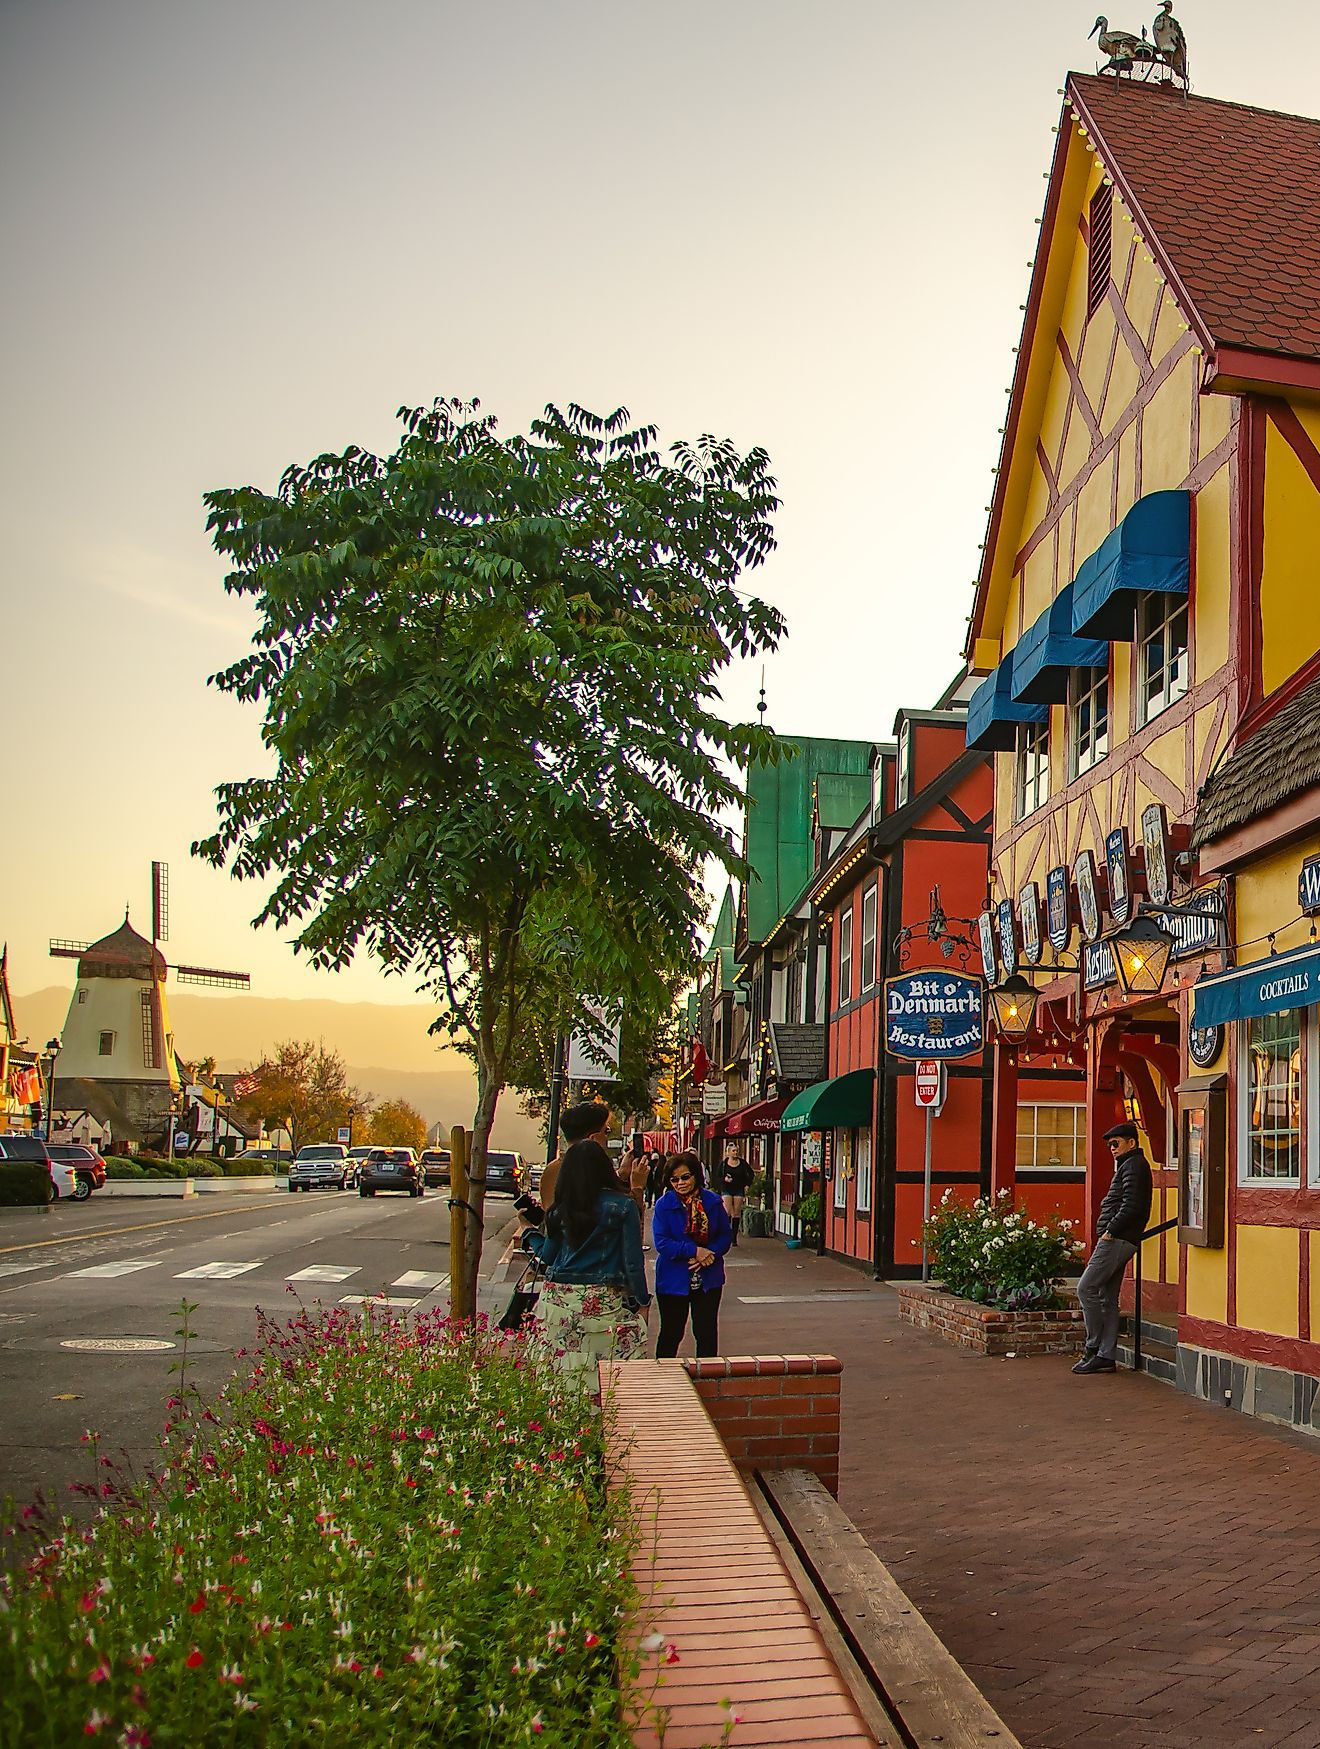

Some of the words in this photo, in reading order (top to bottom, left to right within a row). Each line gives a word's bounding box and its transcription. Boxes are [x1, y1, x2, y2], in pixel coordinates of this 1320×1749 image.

[908, 980, 939, 997] Bit
[944, 981, 962, 998] o'
[1260, 972, 1309, 1001] COCKTAILS
[888, 989, 981, 1015] Denmark
[888, 1024, 982, 1050] Restaurant
[920, 1064, 926, 1075] DO
[926, 1064, 936, 1075] NOT
[920, 1085, 935, 1096] ENTER
